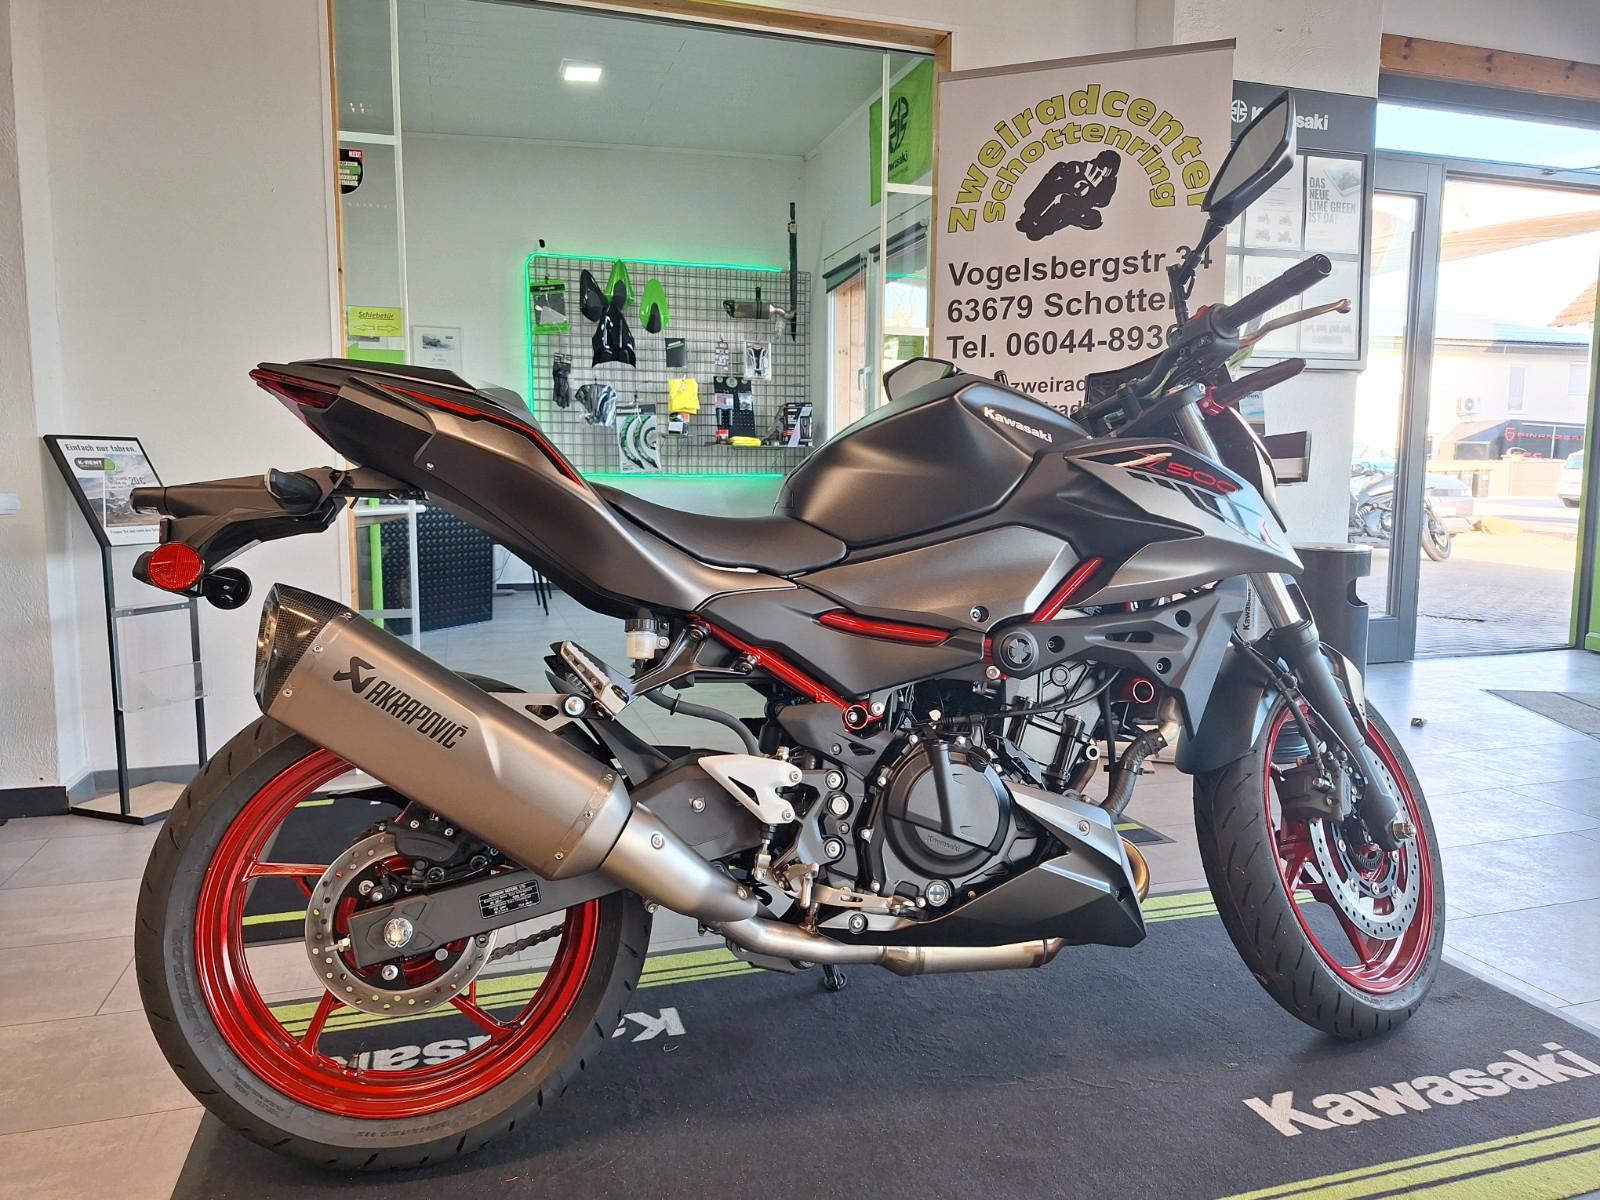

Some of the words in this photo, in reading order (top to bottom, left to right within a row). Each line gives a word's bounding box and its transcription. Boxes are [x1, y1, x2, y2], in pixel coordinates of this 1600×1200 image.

[1251, 105, 1329, 131] Ksaki
[983, 122, 1175, 223] Schottenring
[1309, 177, 1326, 189] DAS
[1309, 189, 1330, 201] NEUE
[1309, 200, 1328, 212] LIME
[1330, 202, 1356, 214] GREEN
[948, 295, 1033, 323] 63679
[947, 335, 995, 359] Tel.
[983, 406, 1053, 443] Kawasaki
[65, 443, 95, 452] Einfach
[1242, 1042, 1600, 1137] Kawasaki
